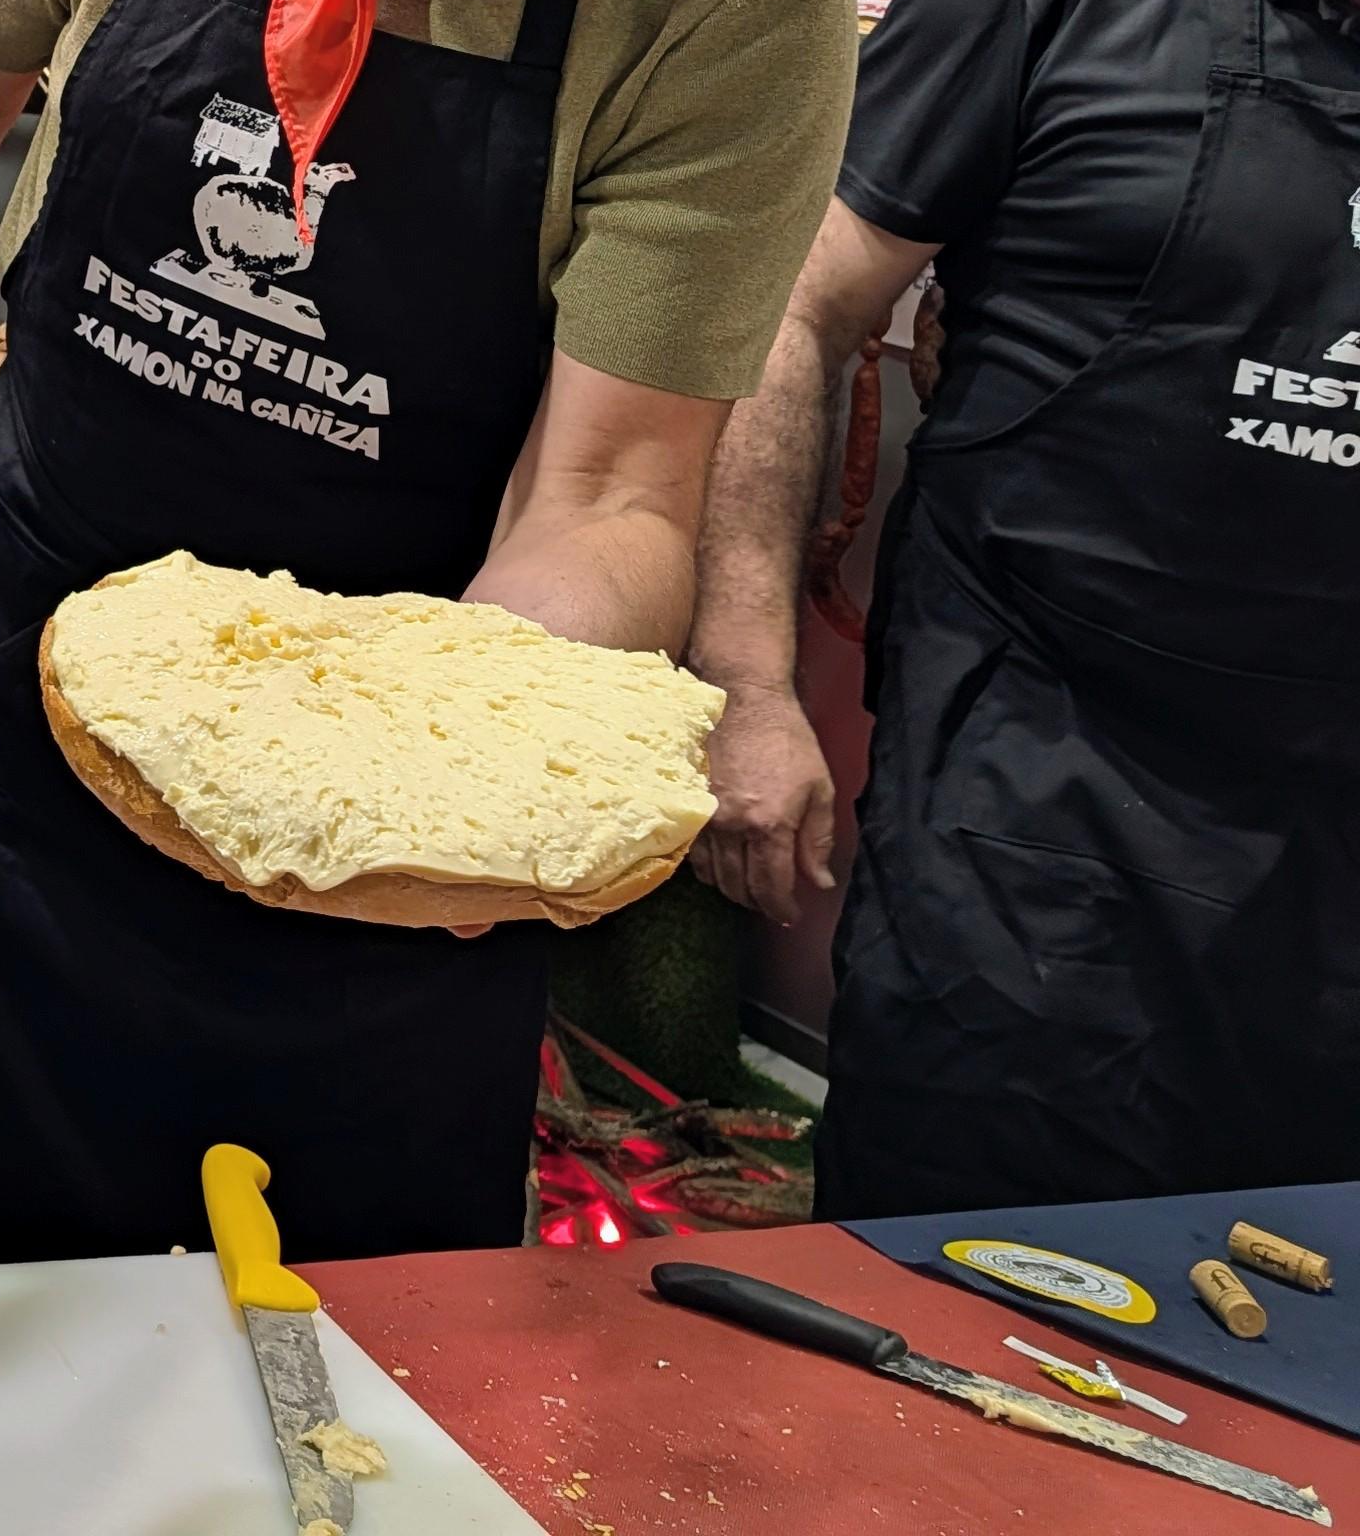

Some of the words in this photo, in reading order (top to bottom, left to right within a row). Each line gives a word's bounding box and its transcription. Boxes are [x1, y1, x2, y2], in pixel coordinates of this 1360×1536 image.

[74, 313, 198, 397] XAMON
[202, 382, 245, 413] NA
[83, 255, 390, 416] FESTA-FEIRA
[191, 350, 241, 382] DO
